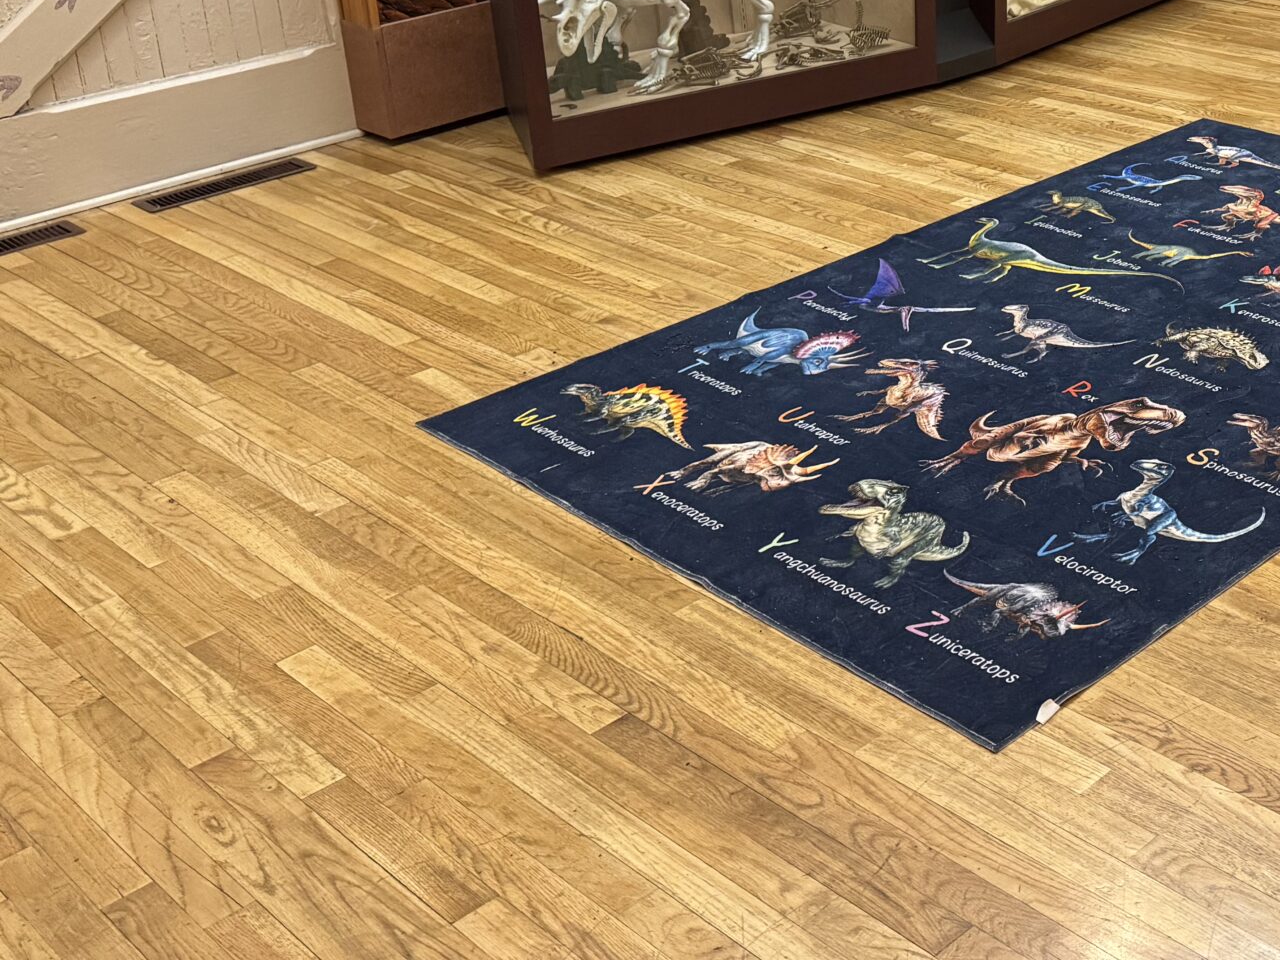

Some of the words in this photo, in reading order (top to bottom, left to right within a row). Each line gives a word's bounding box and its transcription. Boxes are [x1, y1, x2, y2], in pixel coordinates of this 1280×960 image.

[1087, 182, 1162, 208] Elasmosaurus
[1024, 215, 1083, 239] Iguanodon
[1173, 219, 1243, 245] Fukuiraptor
[1093, 250, 1142, 271] Jobaria
[788, 289, 859, 322] Pterodactyl
[1056, 283, 1131, 313] Mussaurus
[941, 337, 1028, 378] Quilmesaurus
[1133, 353, 1223, 393] Nodosaurus
[677, 358, 742, 397] Triceratops
[1062, 380, 1099, 403] Rex
[512, 407, 596, 458] Wuerhosaurus
[778, 406, 851, 446] Utahraptor
[633, 474, 725, 531] Xenoceratops
[757, 531, 893, 616] Yangchuanosaurus
[1037, 534, 1139, 596] Velociraptor
[905, 610, 1021, 685] Zuniceratops
